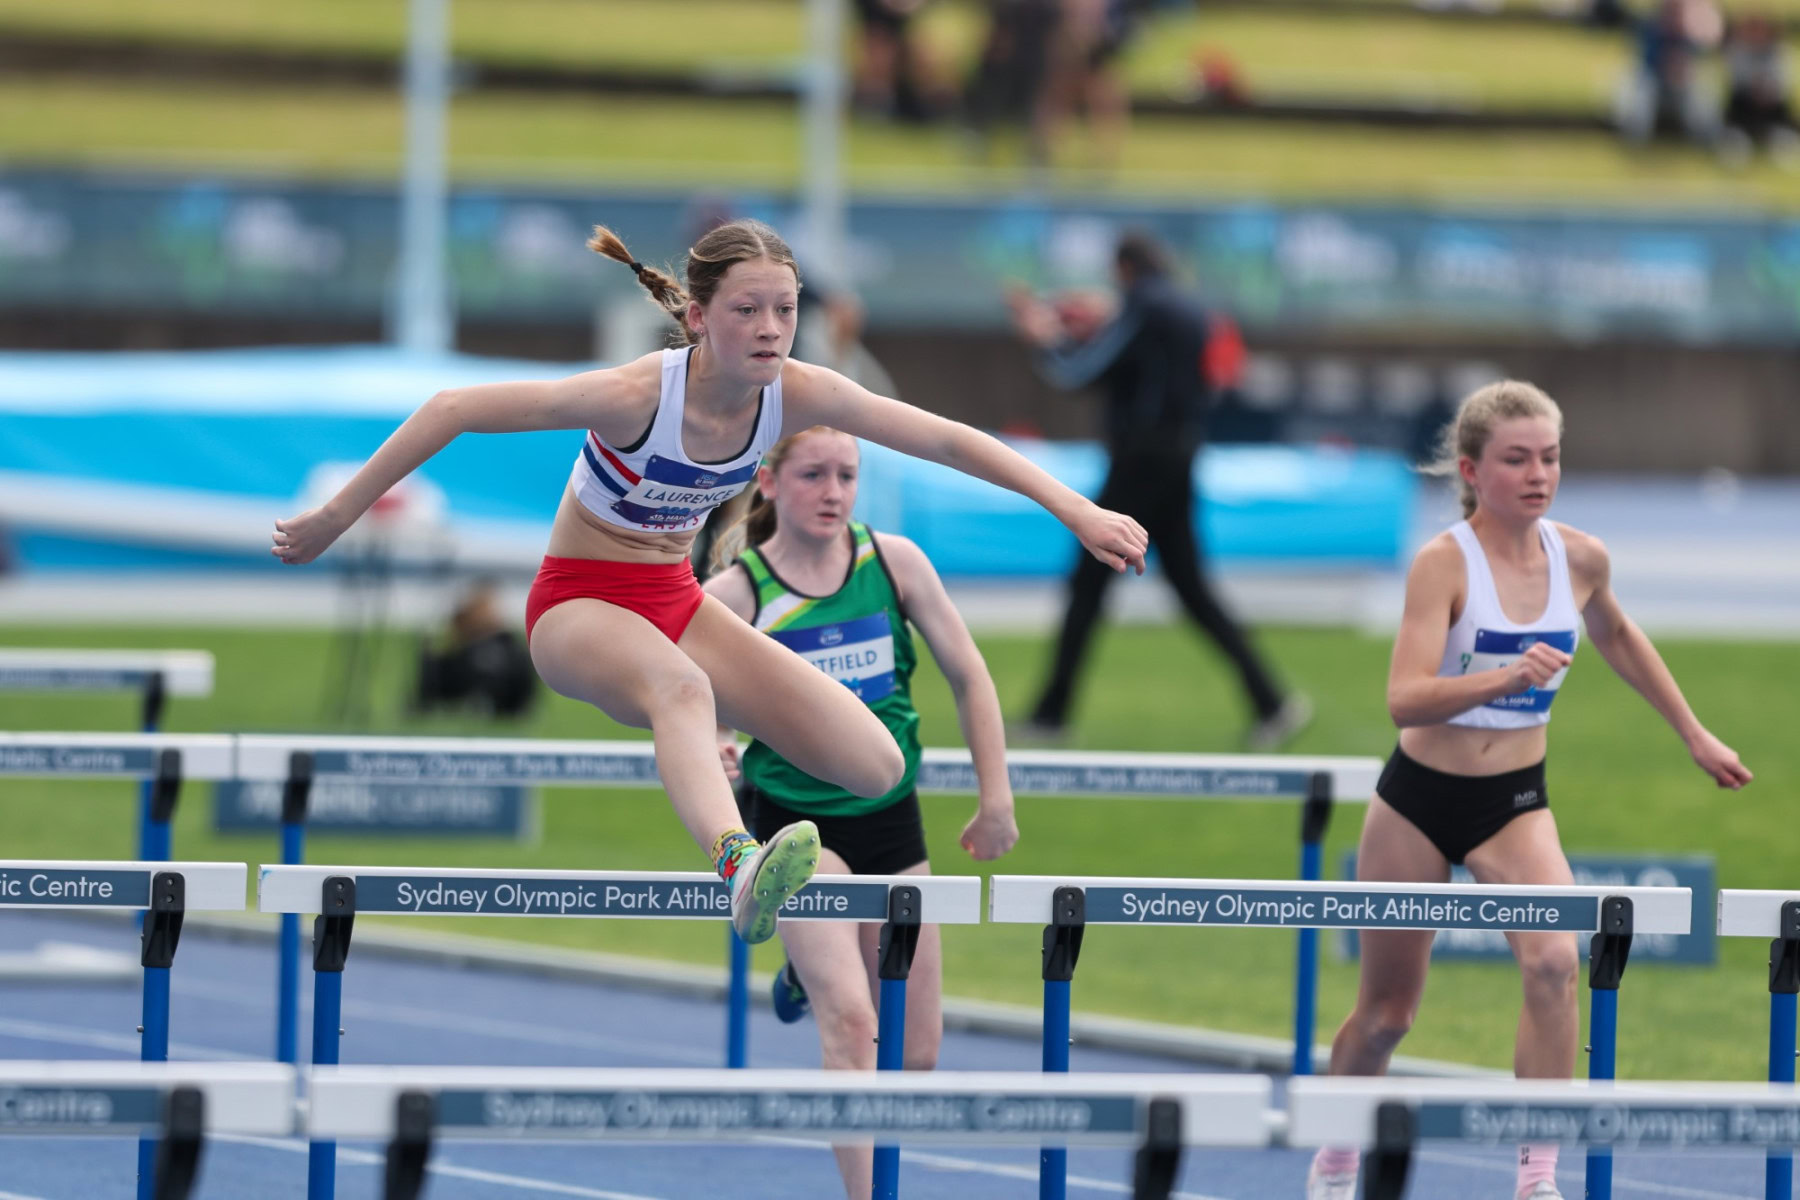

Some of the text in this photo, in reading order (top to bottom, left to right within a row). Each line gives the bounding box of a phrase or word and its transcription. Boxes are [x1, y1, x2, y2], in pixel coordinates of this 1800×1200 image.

[643, 488, 734, 504] LAURENCE
[812, 650, 877, 673] TFIELD
[29, 874, 113, 898] Centre
[397, 882, 488, 912] Sydney
[494, 884, 597, 914] Olympic
[605, 886, 661, 909] Park
[777, 891, 849, 912] entre
[1122, 892, 1560, 924] Sydney Olympic Park Athletic Centre
[487, 1092, 1091, 1133] Sydney Olympic Park Athletic Centre
[1463, 1104, 1584, 1146] Sydney
[1586, 1105, 1728, 1146] Olympic
